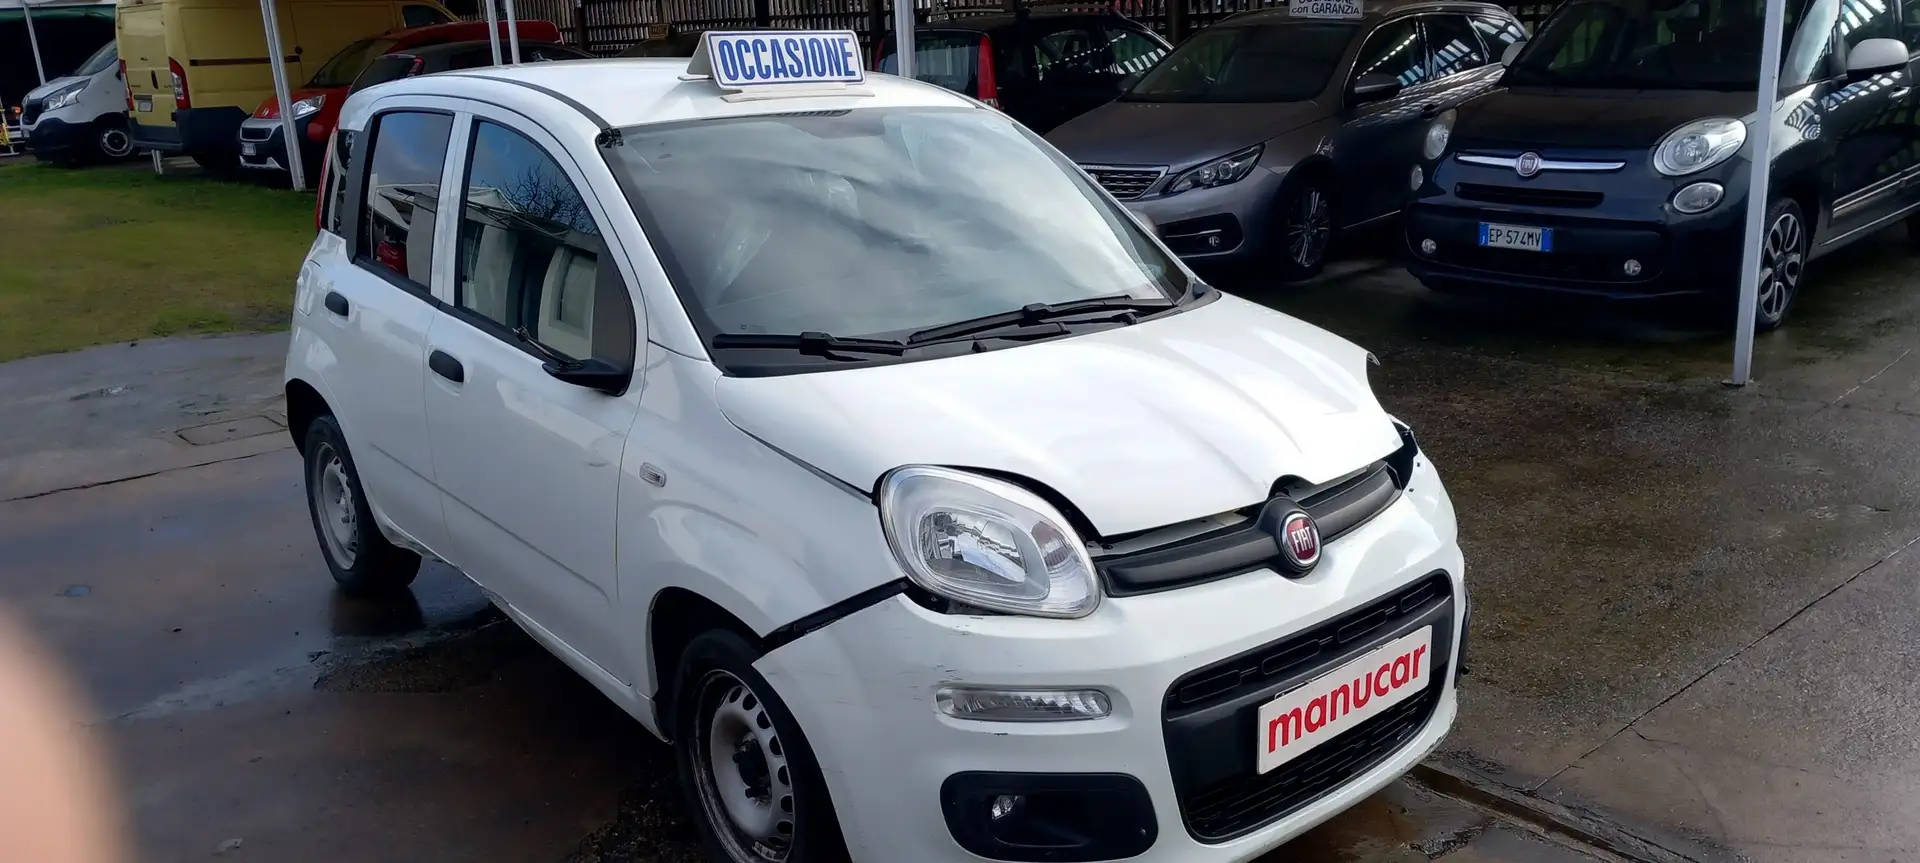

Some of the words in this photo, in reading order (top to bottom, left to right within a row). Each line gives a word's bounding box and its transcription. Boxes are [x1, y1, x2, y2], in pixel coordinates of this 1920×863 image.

[1291, 6, 1309, 14] con
[1311, 3, 1360, 15] GARANZIA
[718, 38, 857, 82] OCCASIONE
[1291, 526, 1313, 554] FIAT
[1268, 643, 1427, 754] manucar
